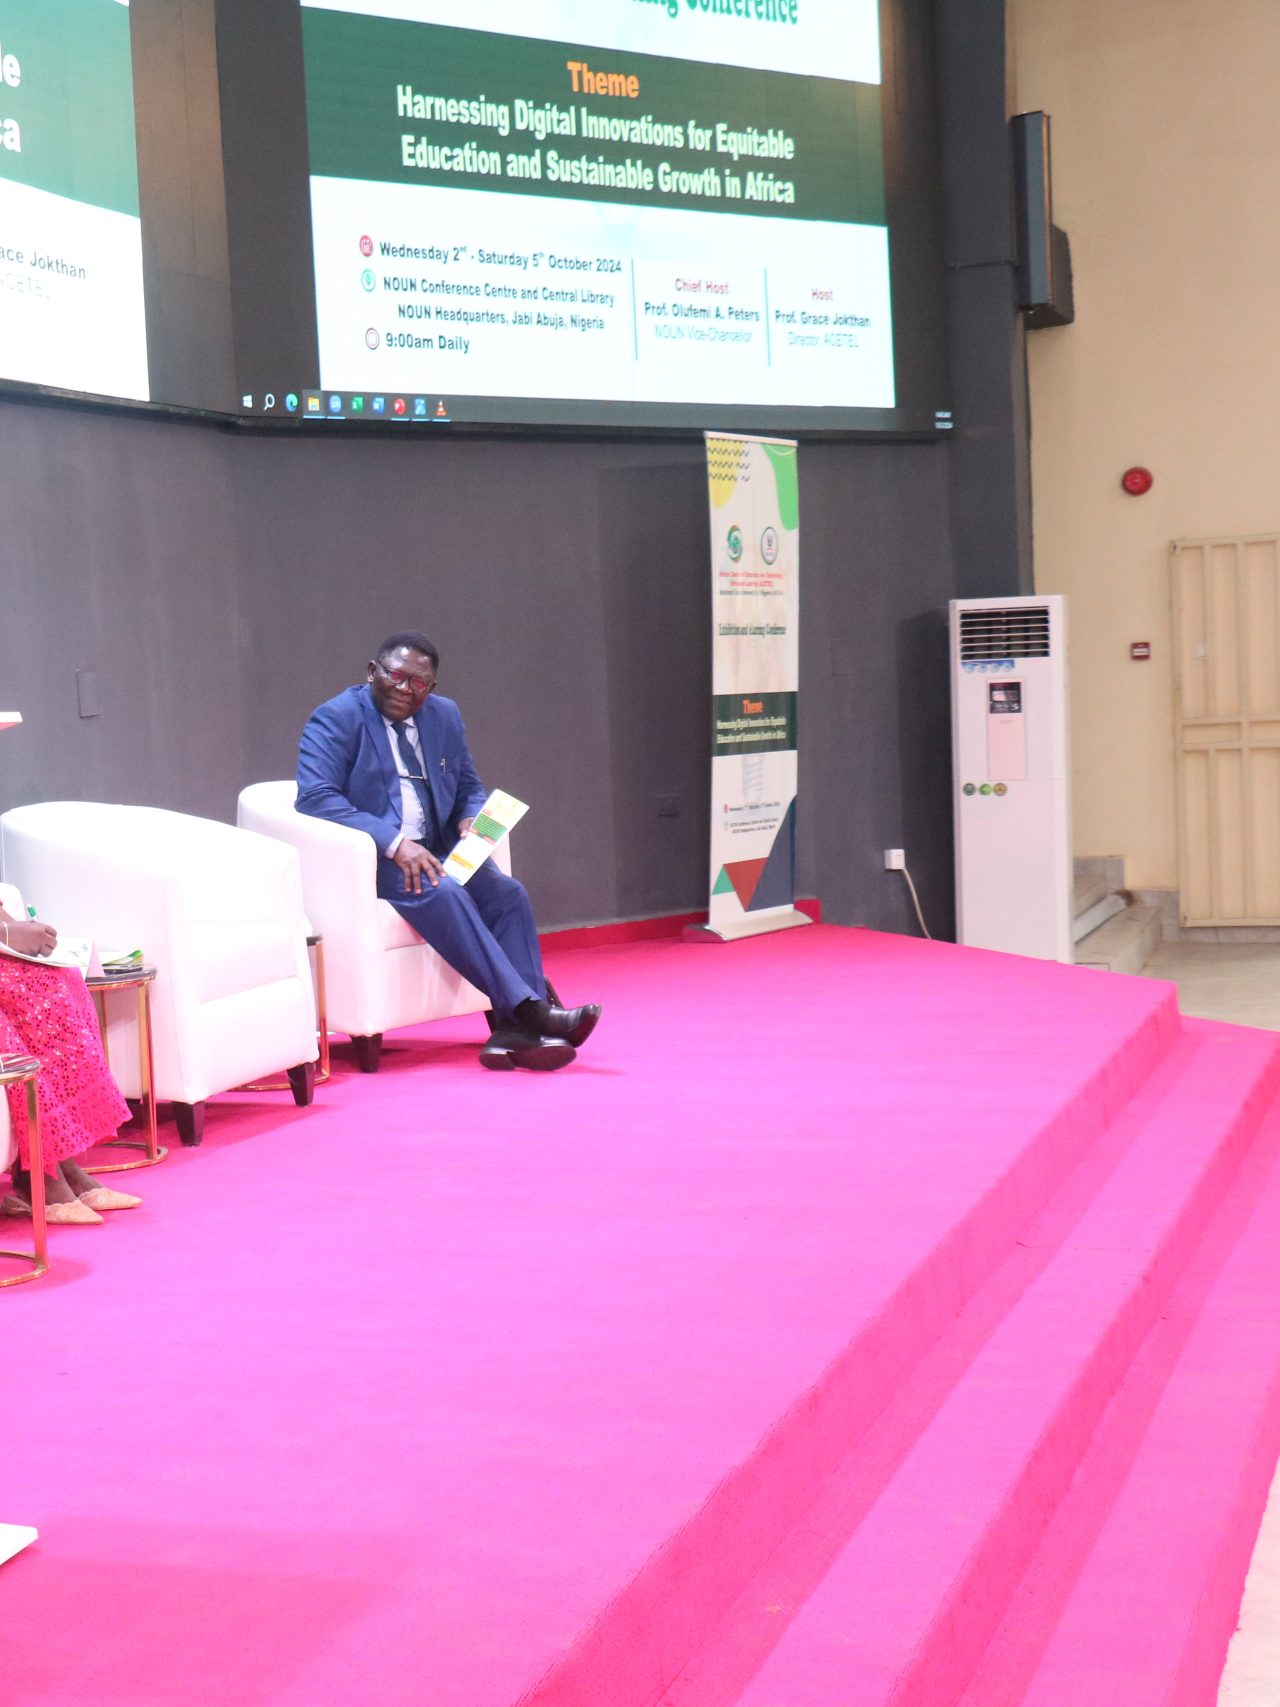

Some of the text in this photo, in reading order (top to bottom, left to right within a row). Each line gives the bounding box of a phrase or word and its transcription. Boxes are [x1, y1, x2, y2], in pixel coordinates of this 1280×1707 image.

[566, 61, 640, 98] Theme
[396, 84, 795, 162] Harnessing Digital Innovations for Equitable
[401, 133, 796, 204] Education and Sustainable Growth in Africa
[30, 251, 87, 280] Jokthan
[379, 241, 449, 265] Wednesday
[477, 249, 529, 270] Saturday
[548, 255, 593, 272] October
[595, 257, 623, 274] 2024
[383, 276, 616, 309] NOUN Conference Centre and Central Library
[674, 278, 702, 293] Chief
[398, 303, 432, 320] NOUN
[511, 310, 534, 326] Jabi
[570, 313, 605, 332] Nigeria
[671, 303, 712, 320] Olufemi
[727, 306, 761, 323] Peters
[800, 311, 830, 326] Grace
[385, 332, 470, 354] 9:00am Daily
